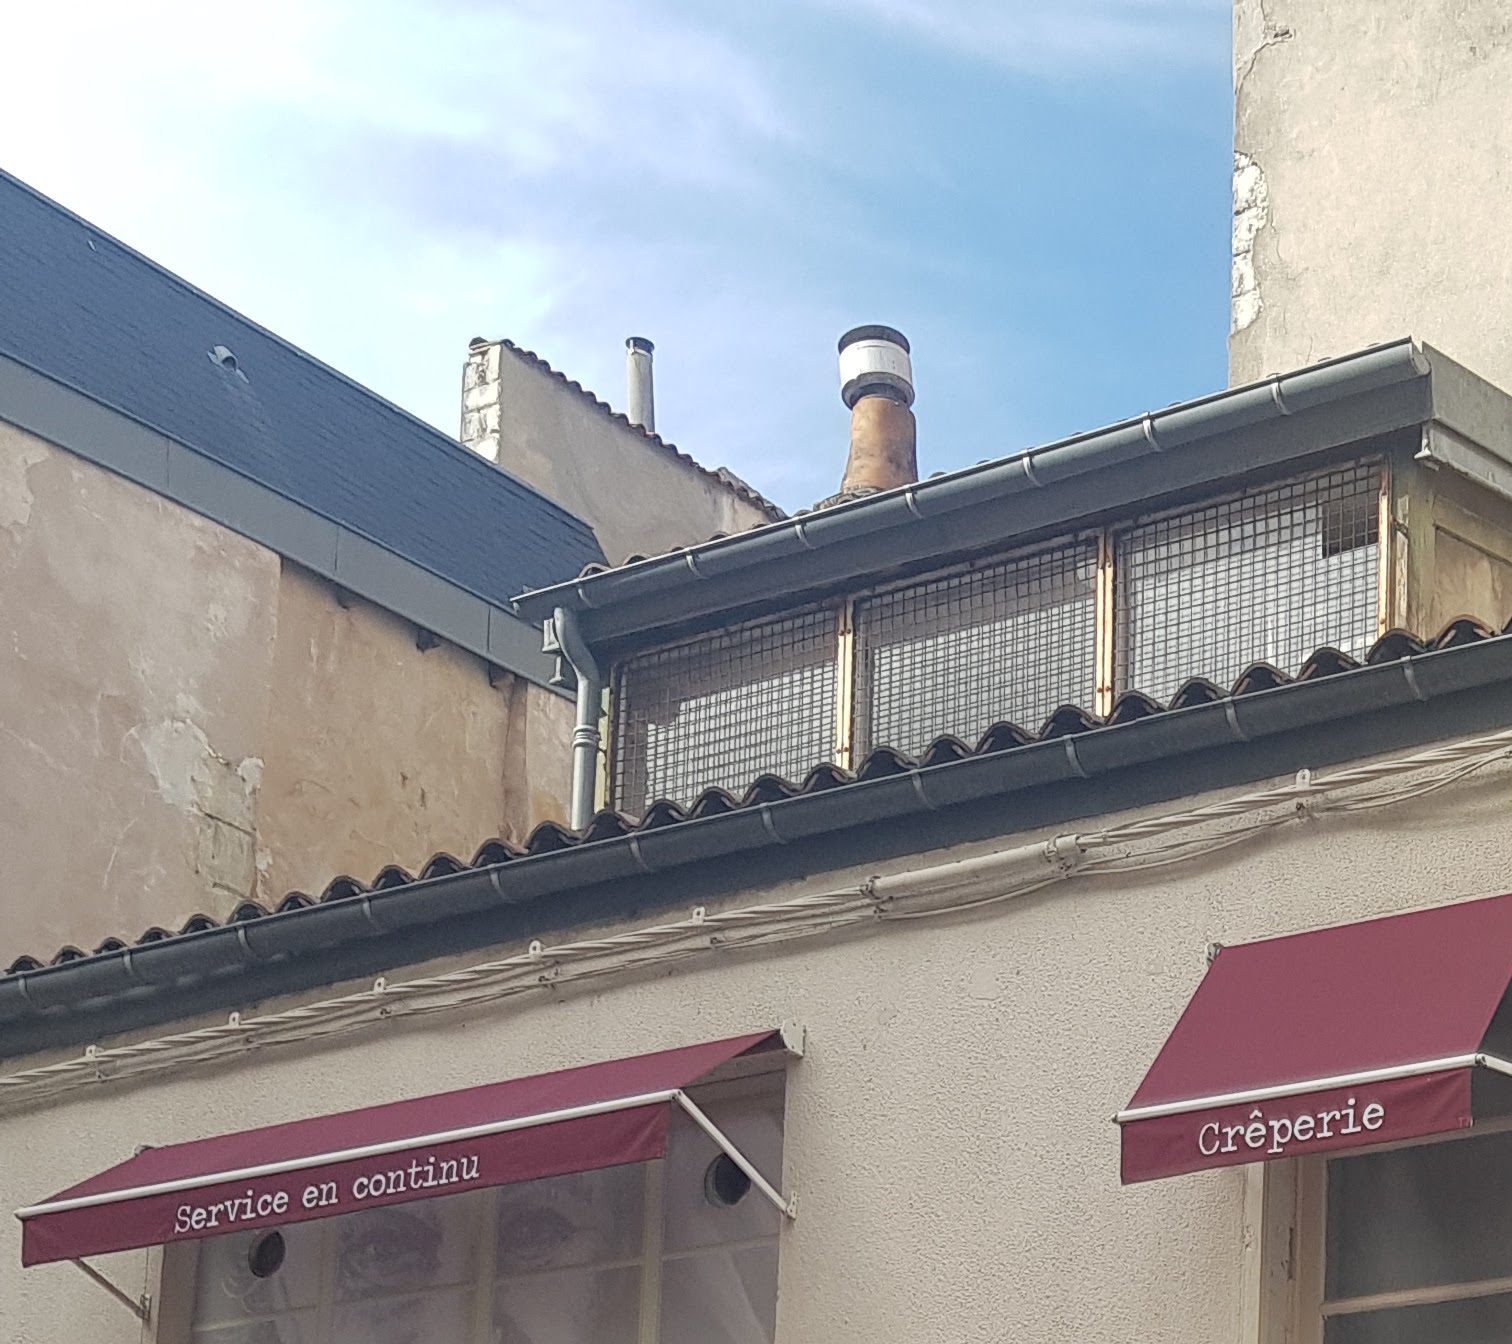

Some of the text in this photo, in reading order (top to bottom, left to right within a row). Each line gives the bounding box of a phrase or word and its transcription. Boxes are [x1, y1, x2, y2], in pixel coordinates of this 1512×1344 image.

[1197, 1097, 1386, 1156] Crêperie
[173, 1154, 481, 1235] Service en continu
